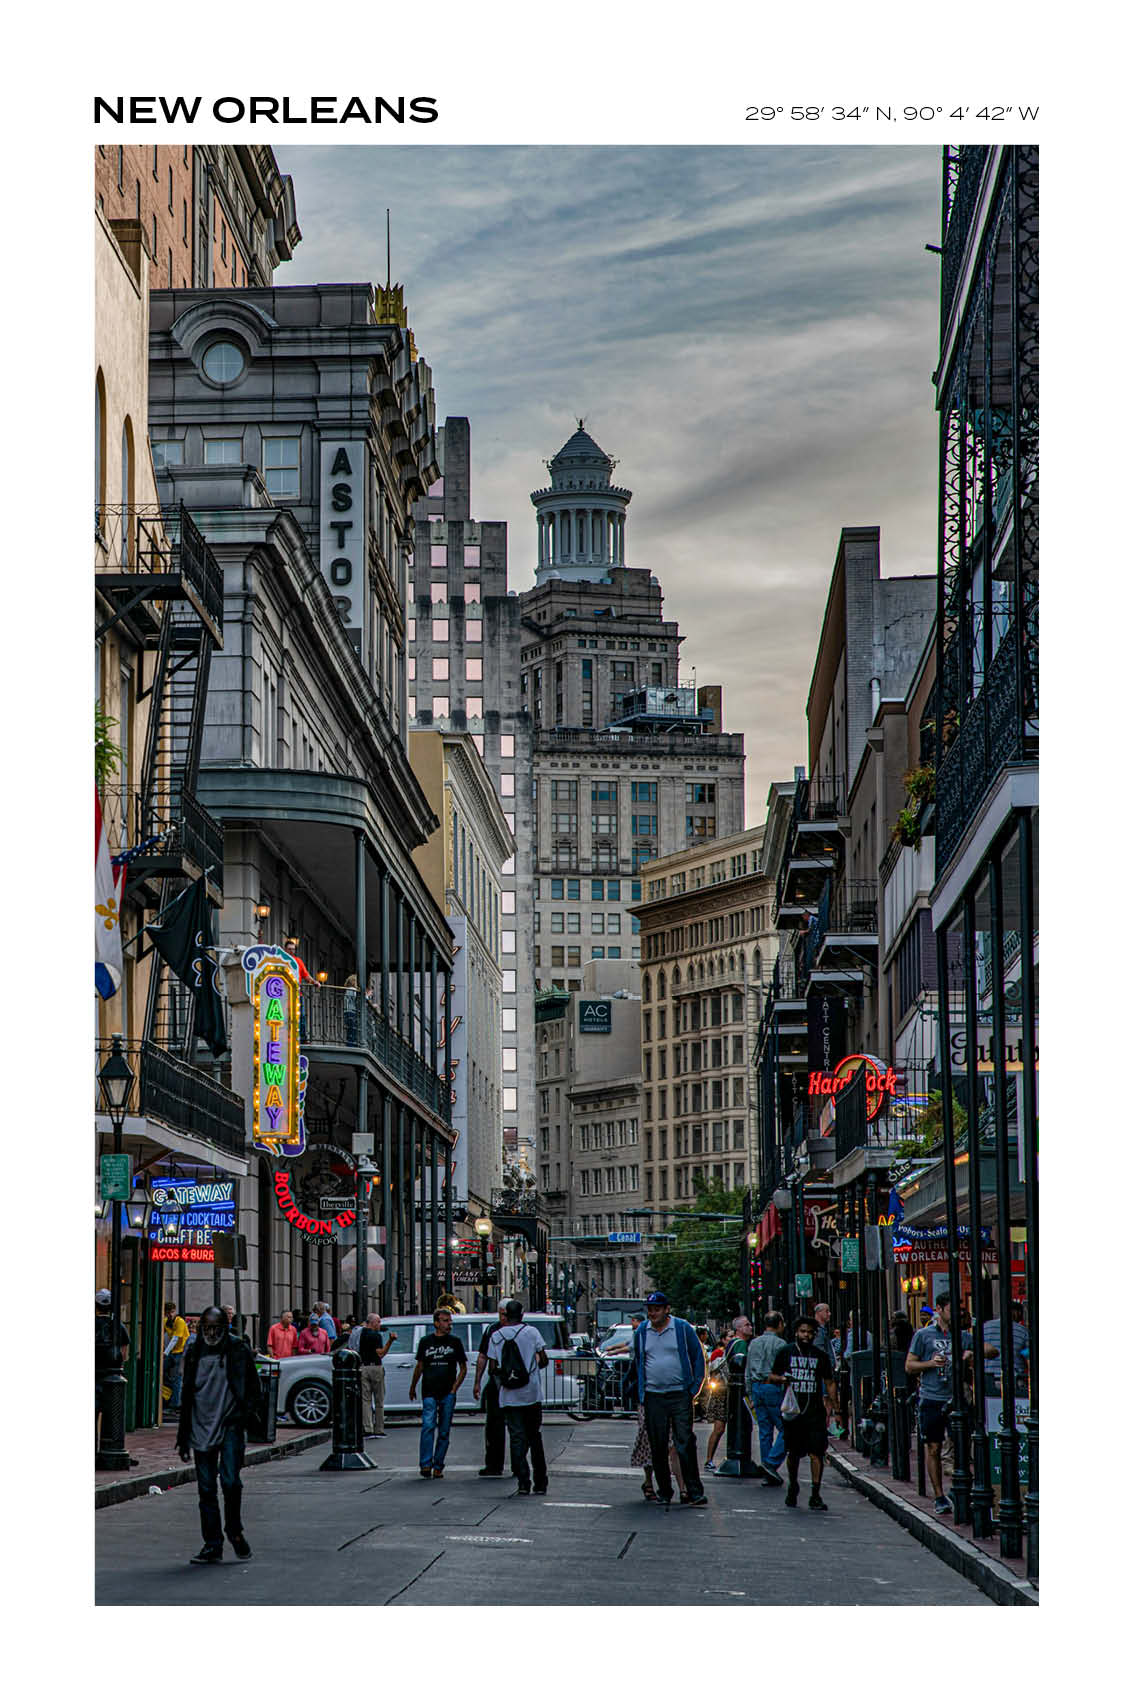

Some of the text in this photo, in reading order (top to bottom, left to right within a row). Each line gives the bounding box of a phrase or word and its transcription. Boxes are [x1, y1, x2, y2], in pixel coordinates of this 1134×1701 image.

[330, 447, 353, 624] ASTOR
[584, 1005, 607, 1017] AC
[263, 976, 286, 1130] GATEWAY
[866, 1067, 897, 1095] ock
[153, 1183, 233, 1206] GATEWAY
[275, 1171, 333, 1234] BOURBON
[186, 1212, 234, 1227] COCKTAILS
